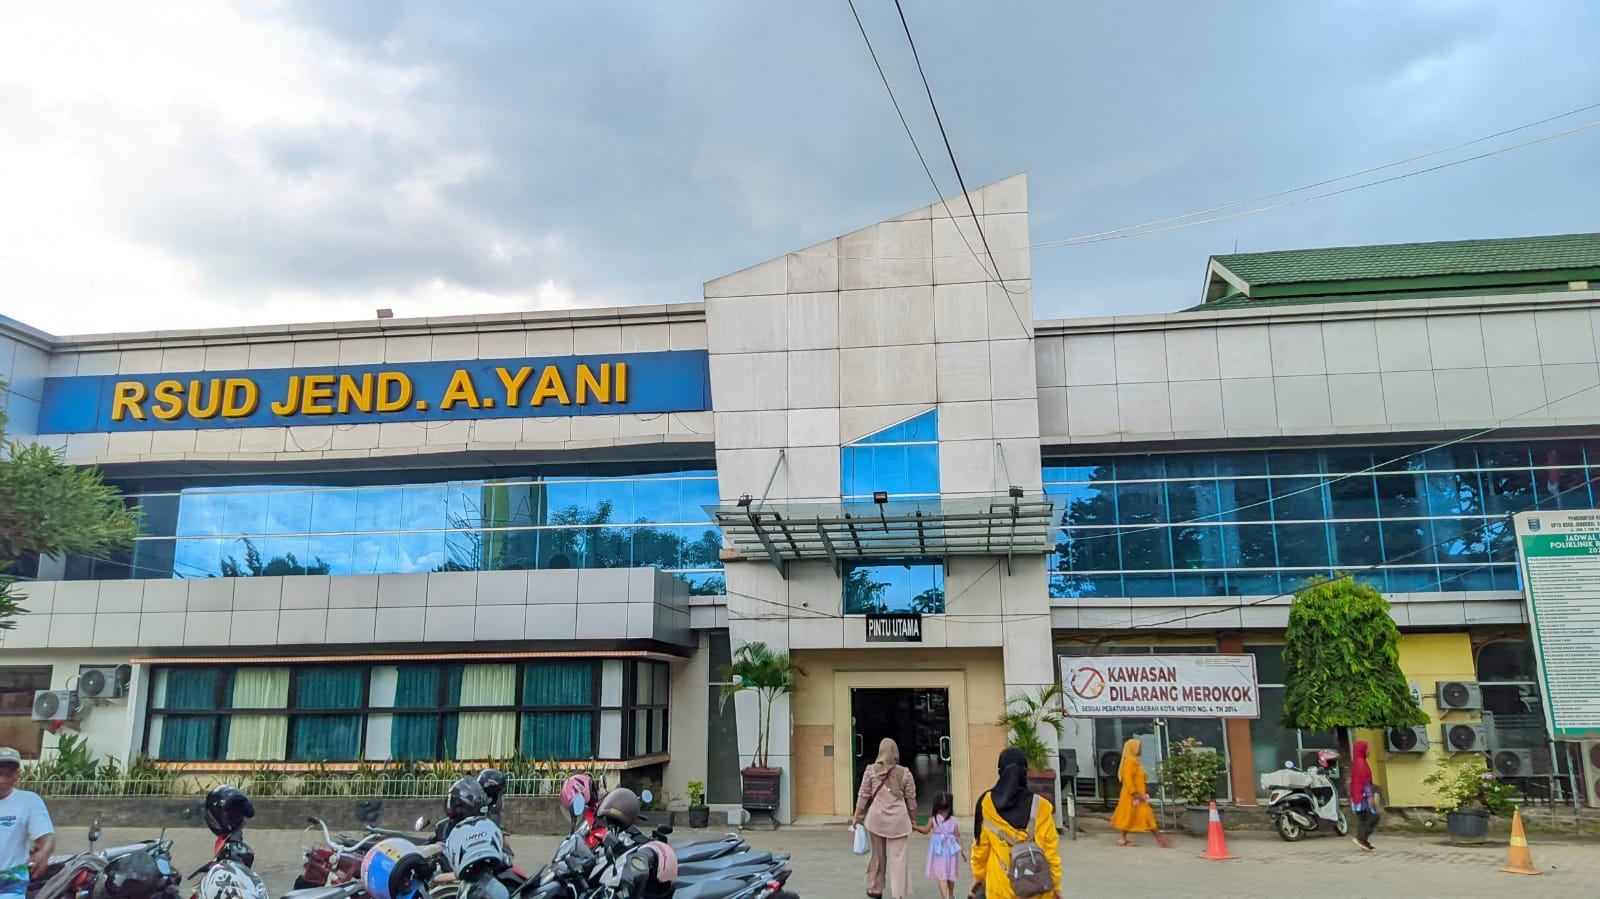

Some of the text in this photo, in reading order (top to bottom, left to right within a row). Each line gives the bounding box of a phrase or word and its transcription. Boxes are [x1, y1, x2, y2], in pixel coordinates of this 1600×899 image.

[111, 362, 628, 421] RSUD JEND. A.YANI
[1550, 540, 1594, 549] POLIKLINIK
[1565, 533, 1597, 541] JADWAL
[868, 618, 920, 637] PINTU UTAMA
[1107, 666, 1177, 682] KAWASAN
[1109, 686, 1253, 703] DILARANG MEROKOK
[1198, 705, 1208, 713] NO.
